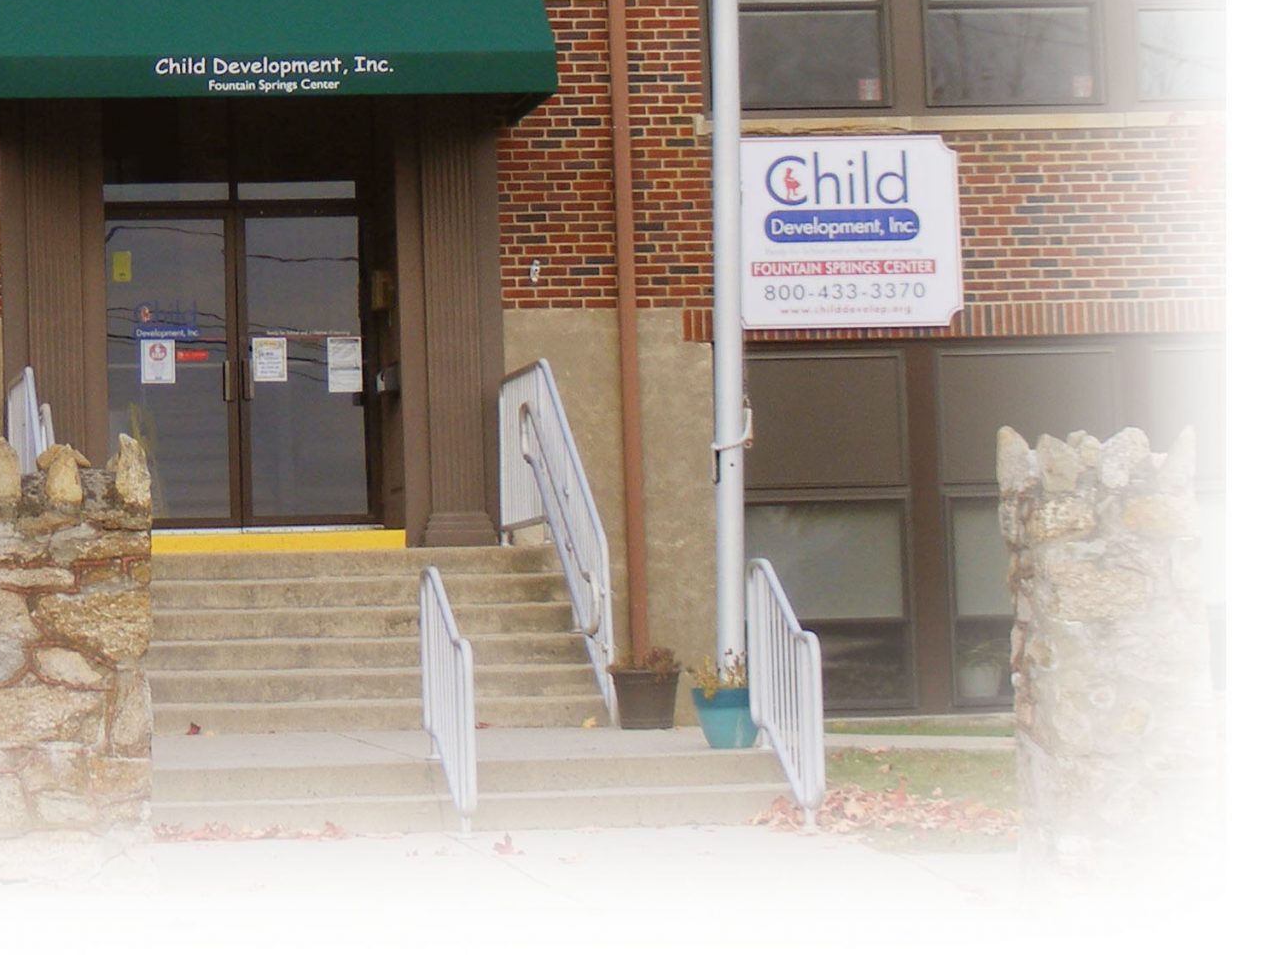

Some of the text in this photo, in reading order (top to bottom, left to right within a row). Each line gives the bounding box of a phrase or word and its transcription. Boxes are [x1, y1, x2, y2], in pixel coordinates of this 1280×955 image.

[155, 56, 394, 77] Child Development, Inc.
[209, 78, 340, 94] Fountain Springs Center
[765, 150, 909, 206] Child
[771, 216, 919, 239] Development, Inc.
[754, 259, 934, 276] FOUNTAIN SPRINGS CENTER
[764, 282, 927, 301] 800-433-3370
